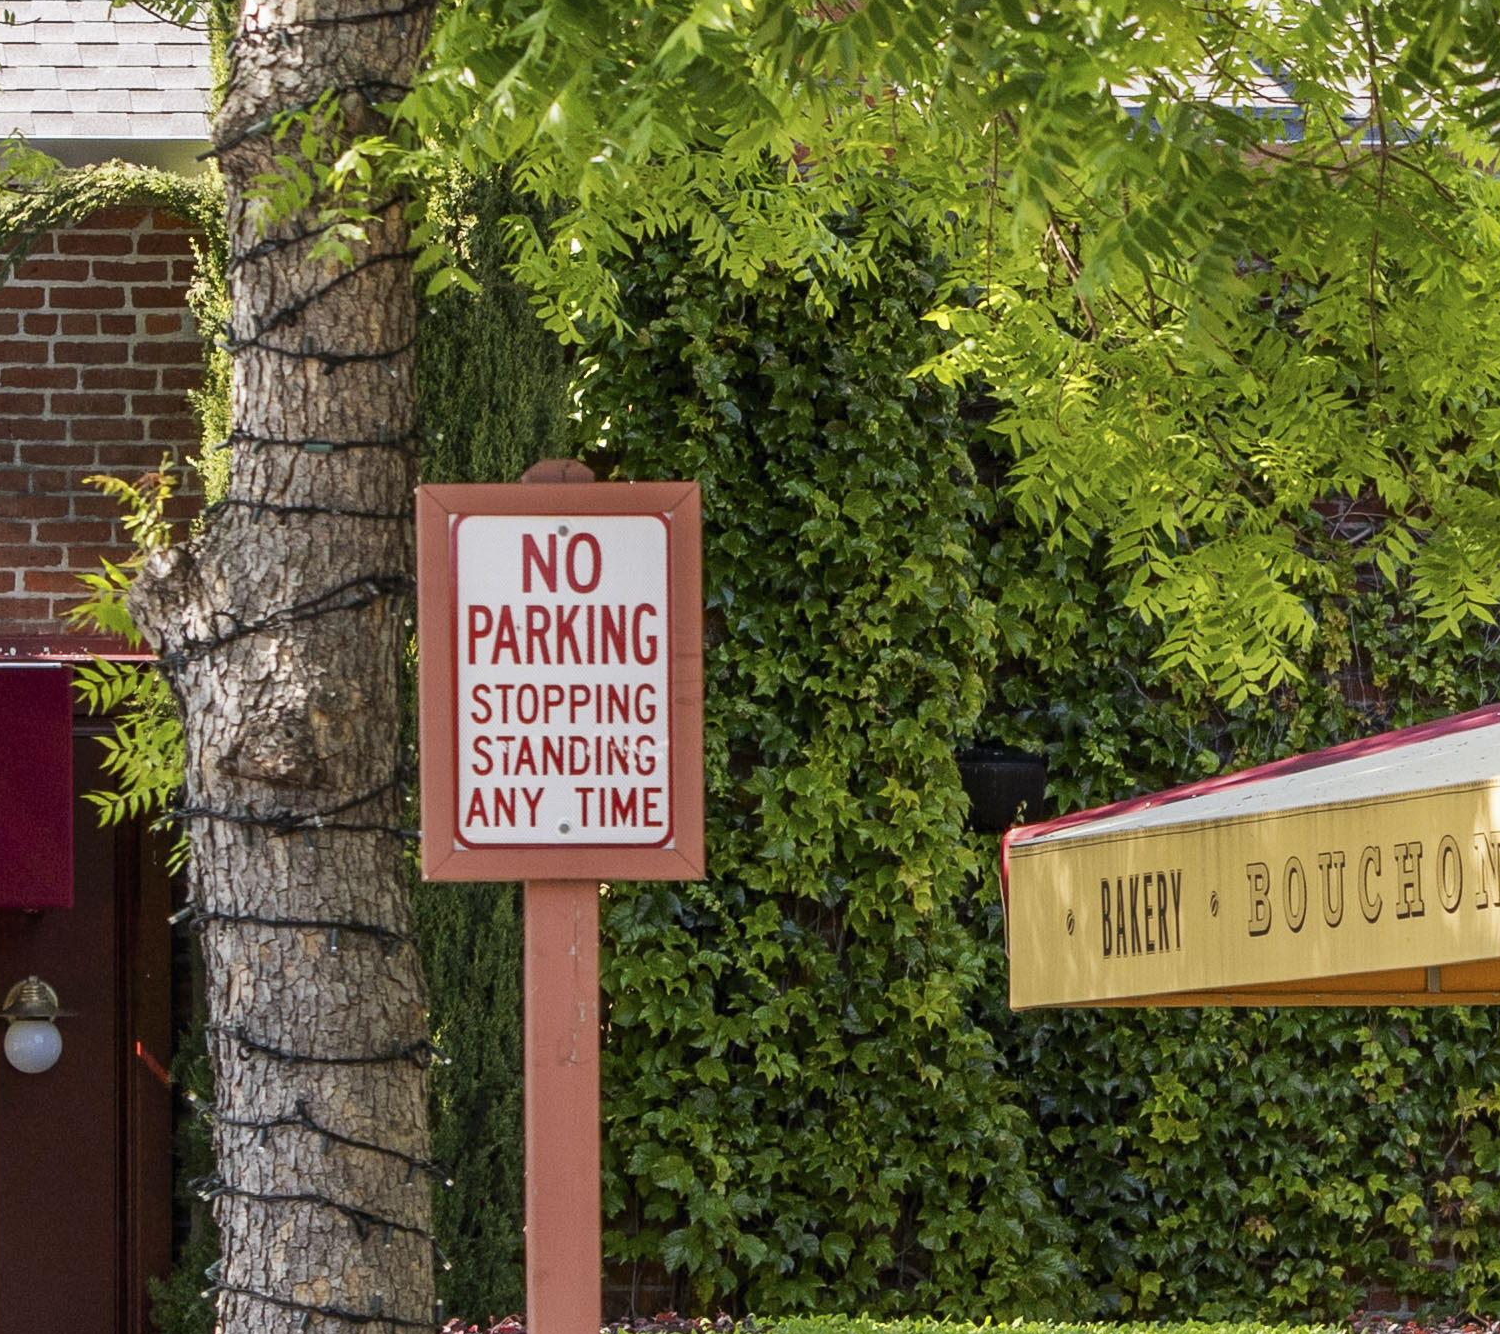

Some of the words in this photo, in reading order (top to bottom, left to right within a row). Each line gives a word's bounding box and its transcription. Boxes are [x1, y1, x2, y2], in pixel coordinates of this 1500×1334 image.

[522, 532, 601, 594] NO
[467, 602, 658, 666] PARKING
[471, 683, 656, 725] STOPPING
[471, 735, 656, 777] STANDING
[466, 786, 545, 828] ANY
[575, 786, 663, 828] TIME
[1101, 869, 1183, 959] BAKERY
